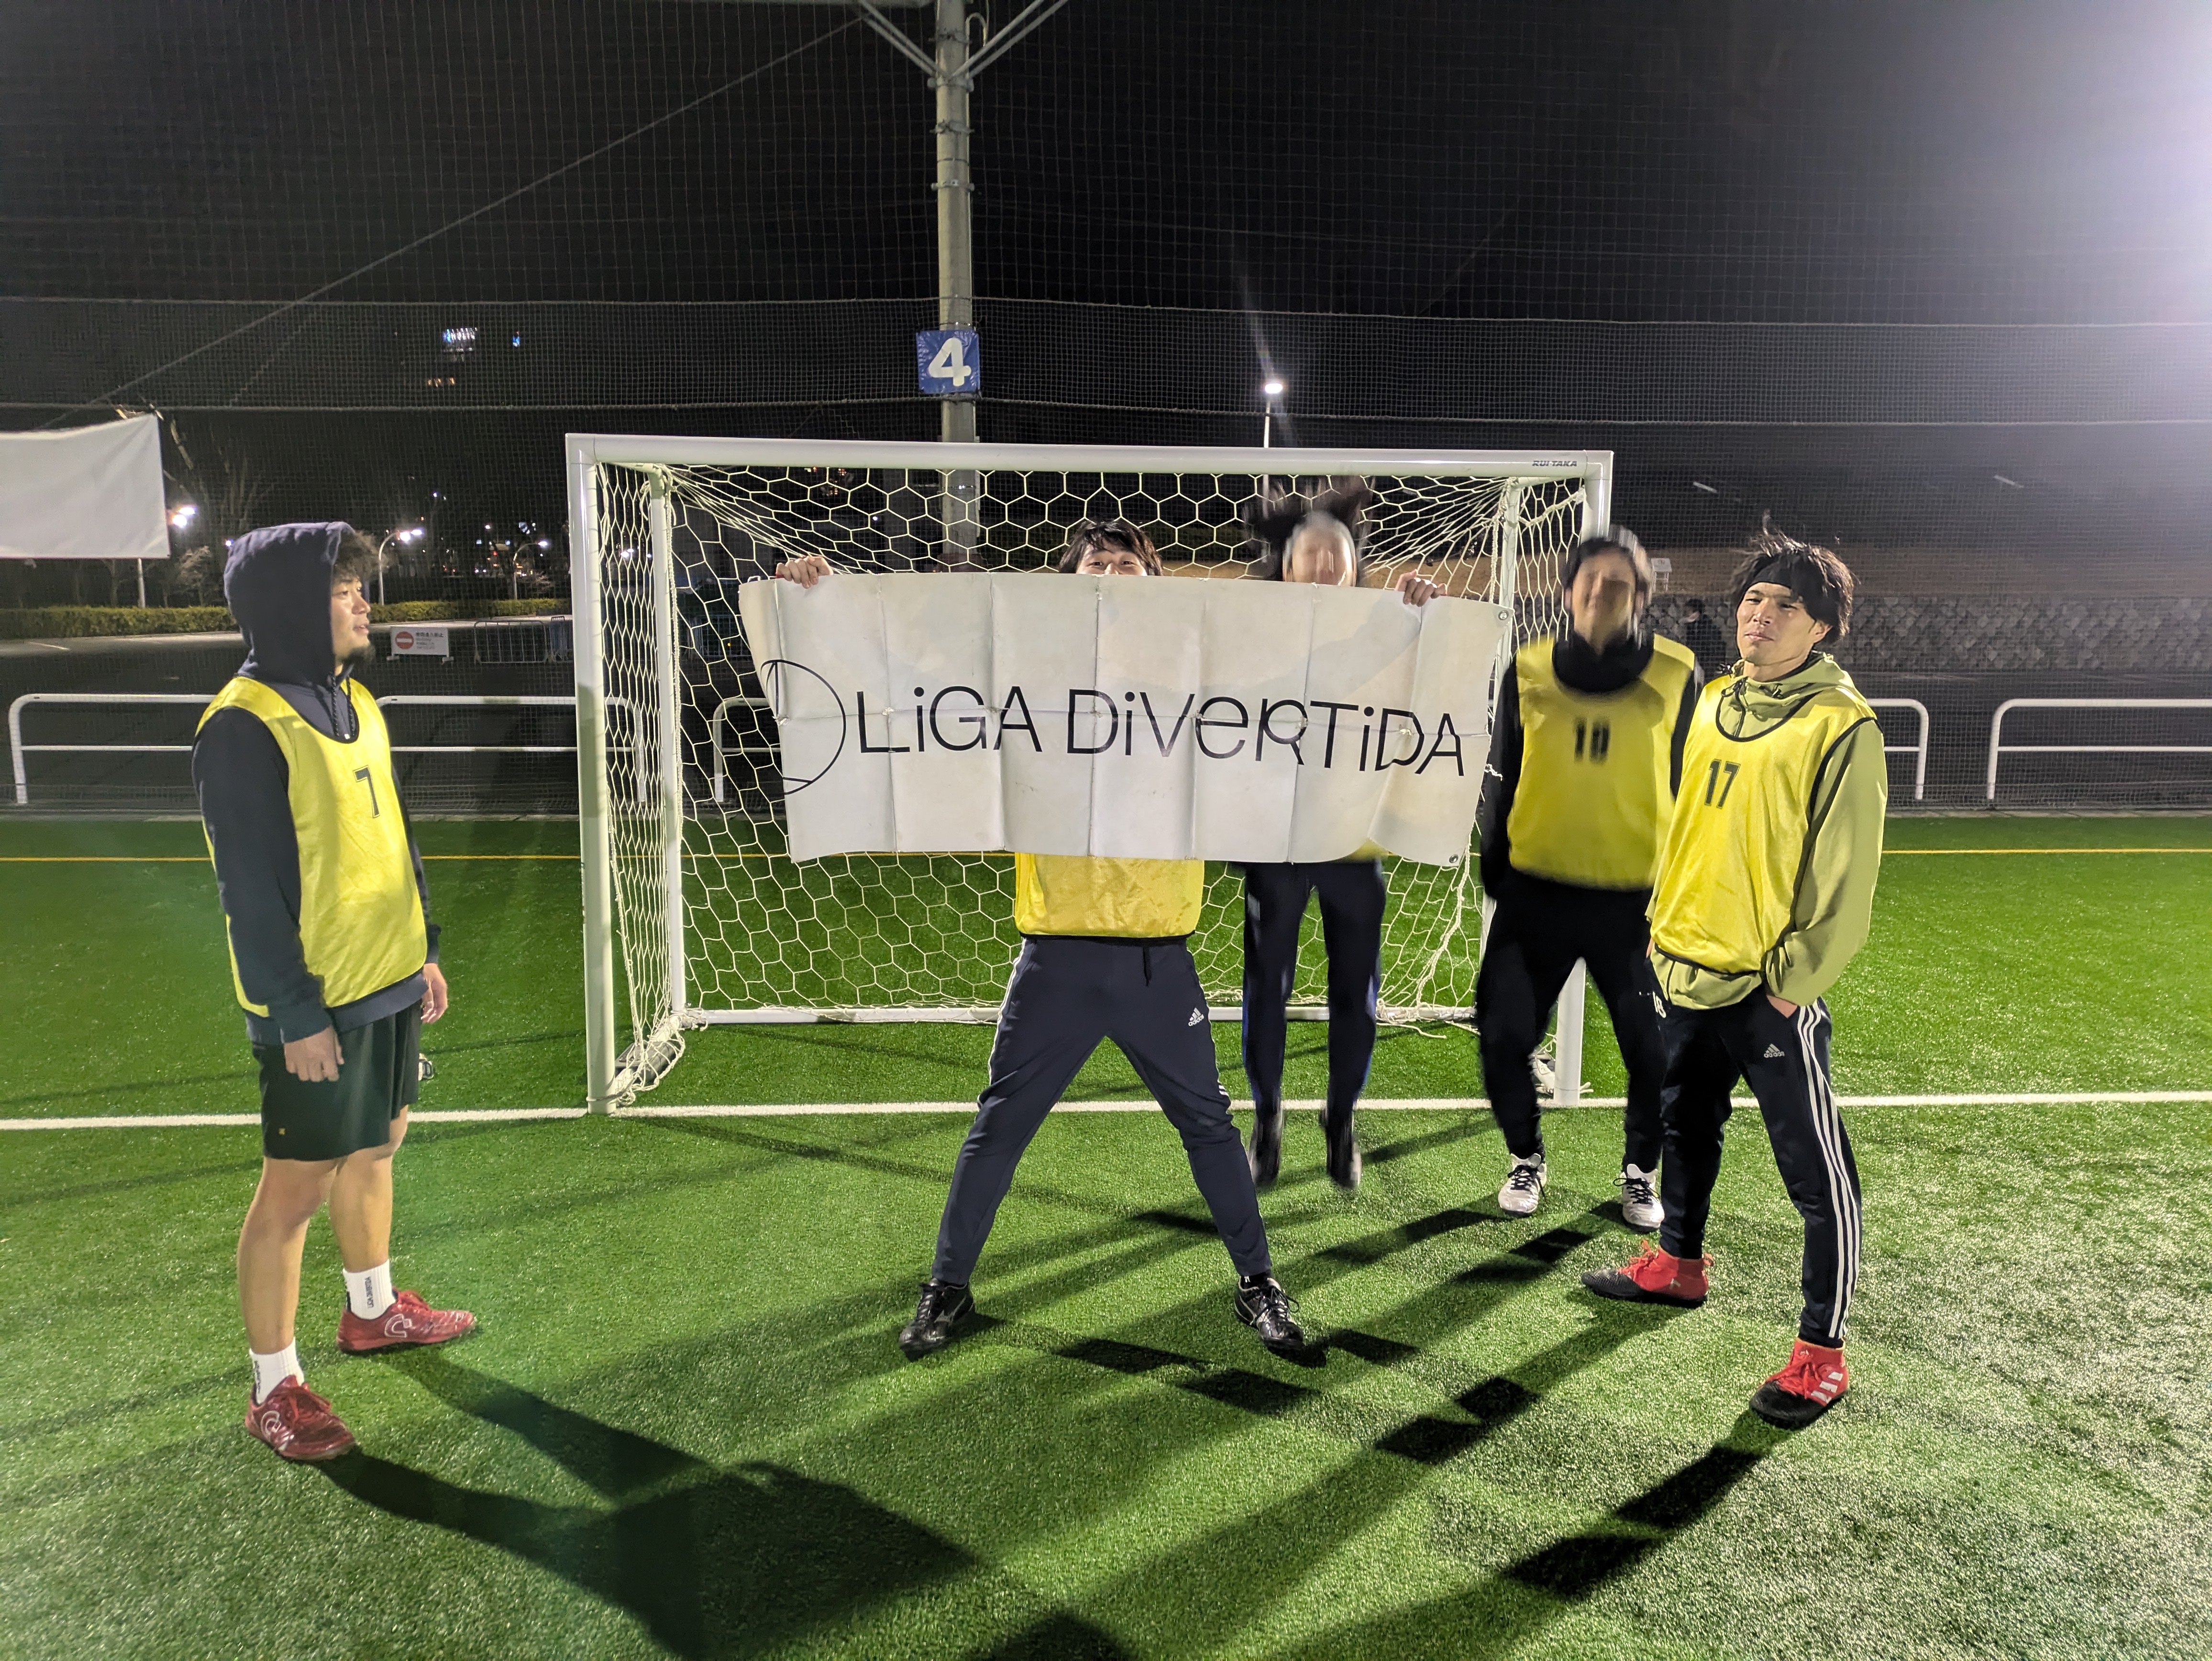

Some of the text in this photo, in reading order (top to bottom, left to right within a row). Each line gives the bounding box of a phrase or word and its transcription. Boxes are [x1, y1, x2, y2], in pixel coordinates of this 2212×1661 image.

[929, 337, 972, 387] 4
[353, 764, 380, 819] 7
[1704, 758, 1741, 809] 17
[1188, 1014, 1204, 1026] adidas
